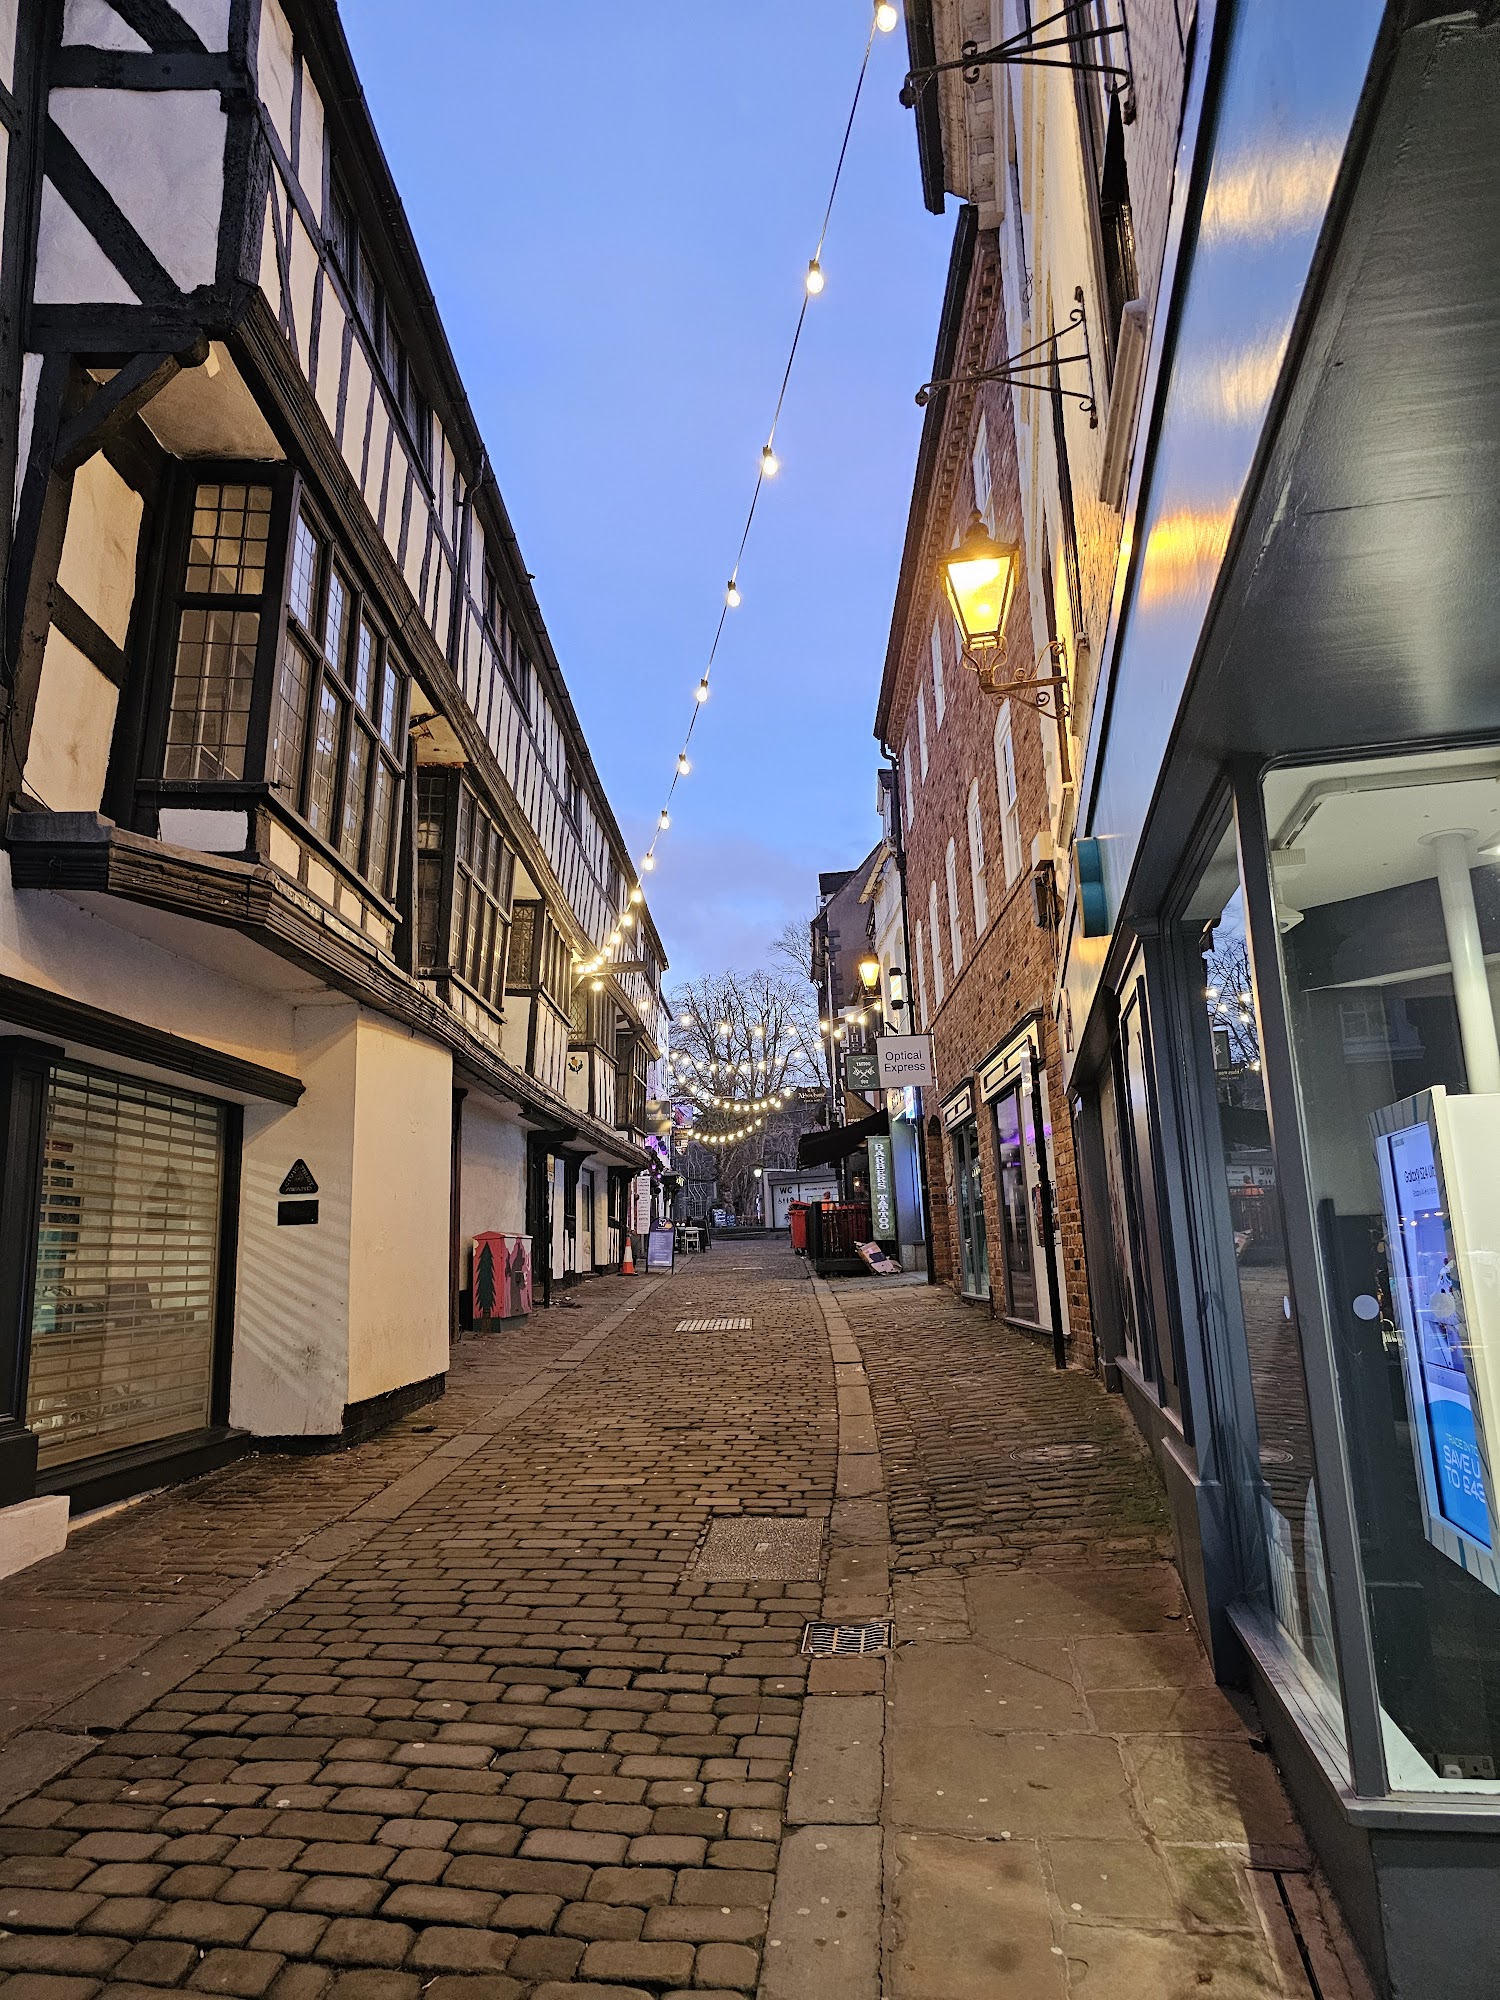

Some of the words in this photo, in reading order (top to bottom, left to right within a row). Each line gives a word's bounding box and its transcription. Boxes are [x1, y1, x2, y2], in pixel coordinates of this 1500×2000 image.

[884, 1063, 926, 1074] Express
[885, 1050, 922, 1062] Optical
[874, 1143, 887, 1190] BARBERS
[779, 1186, 793, 1195] WC
[876, 1194, 889, 1230] TATTOO
[1443, 1444, 1471, 1476] SAVE
[1444, 1464, 1461, 1489] TO
